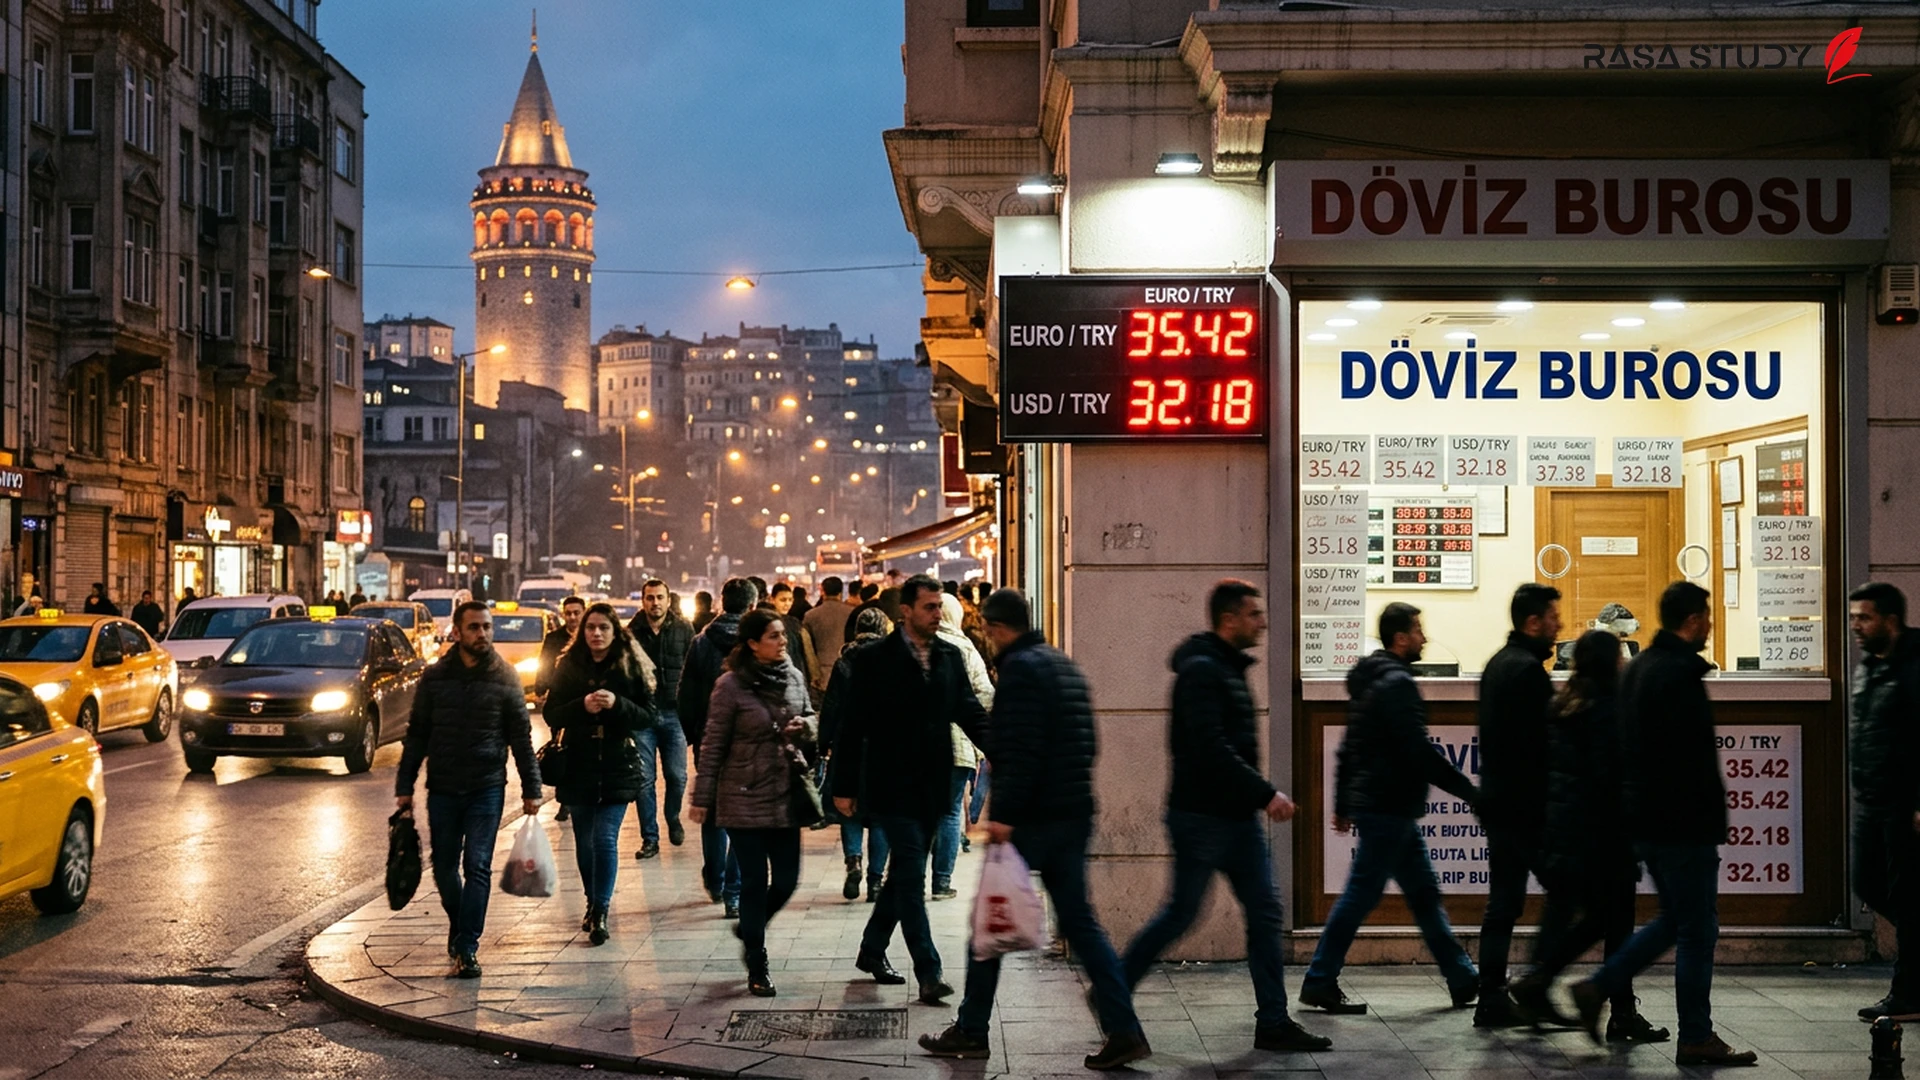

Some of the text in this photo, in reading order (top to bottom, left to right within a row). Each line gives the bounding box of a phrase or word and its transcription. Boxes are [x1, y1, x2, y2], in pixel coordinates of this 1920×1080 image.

[1310, 165, 1853, 237] DÖVİZ BUROSU
[1145, 287, 1190, 304] EURO
[1202, 287, 1235, 303] TRY
[1009, 325, 1064, 347] EURO
[1079, 325, 1118, 346] TRY
[1128, 311, 1253, 357] 35.42
[1340, 338, 1782, 401] DÖVİZ BUROSU
[1010, 393, 1054, 415] USD
[1070, 393, 1111, 415] TRY
[1128, 379, 1253, 426] 32.18
[1308, 459, 1361, 478] 35.42
[1382, 460, 1436, 479] 35.42
[1455, 458, 1507, 477] 32.18
[1621, 465, 1672, 483] 32.18
[1307, 536, 1359, 555] 35.18
[1763, 545, 1811, 562] 32.18
[1339, 568, 1360, 579] TRY
[1750, 736, 1781, 749] TRY
[1726, 758, 1790, 779] 35.42
[1726, 790, 1790, 810] 35.42
[1726, 826, 1791, 846] 32.18
[1727, 863, 1791, 883] 32.18
